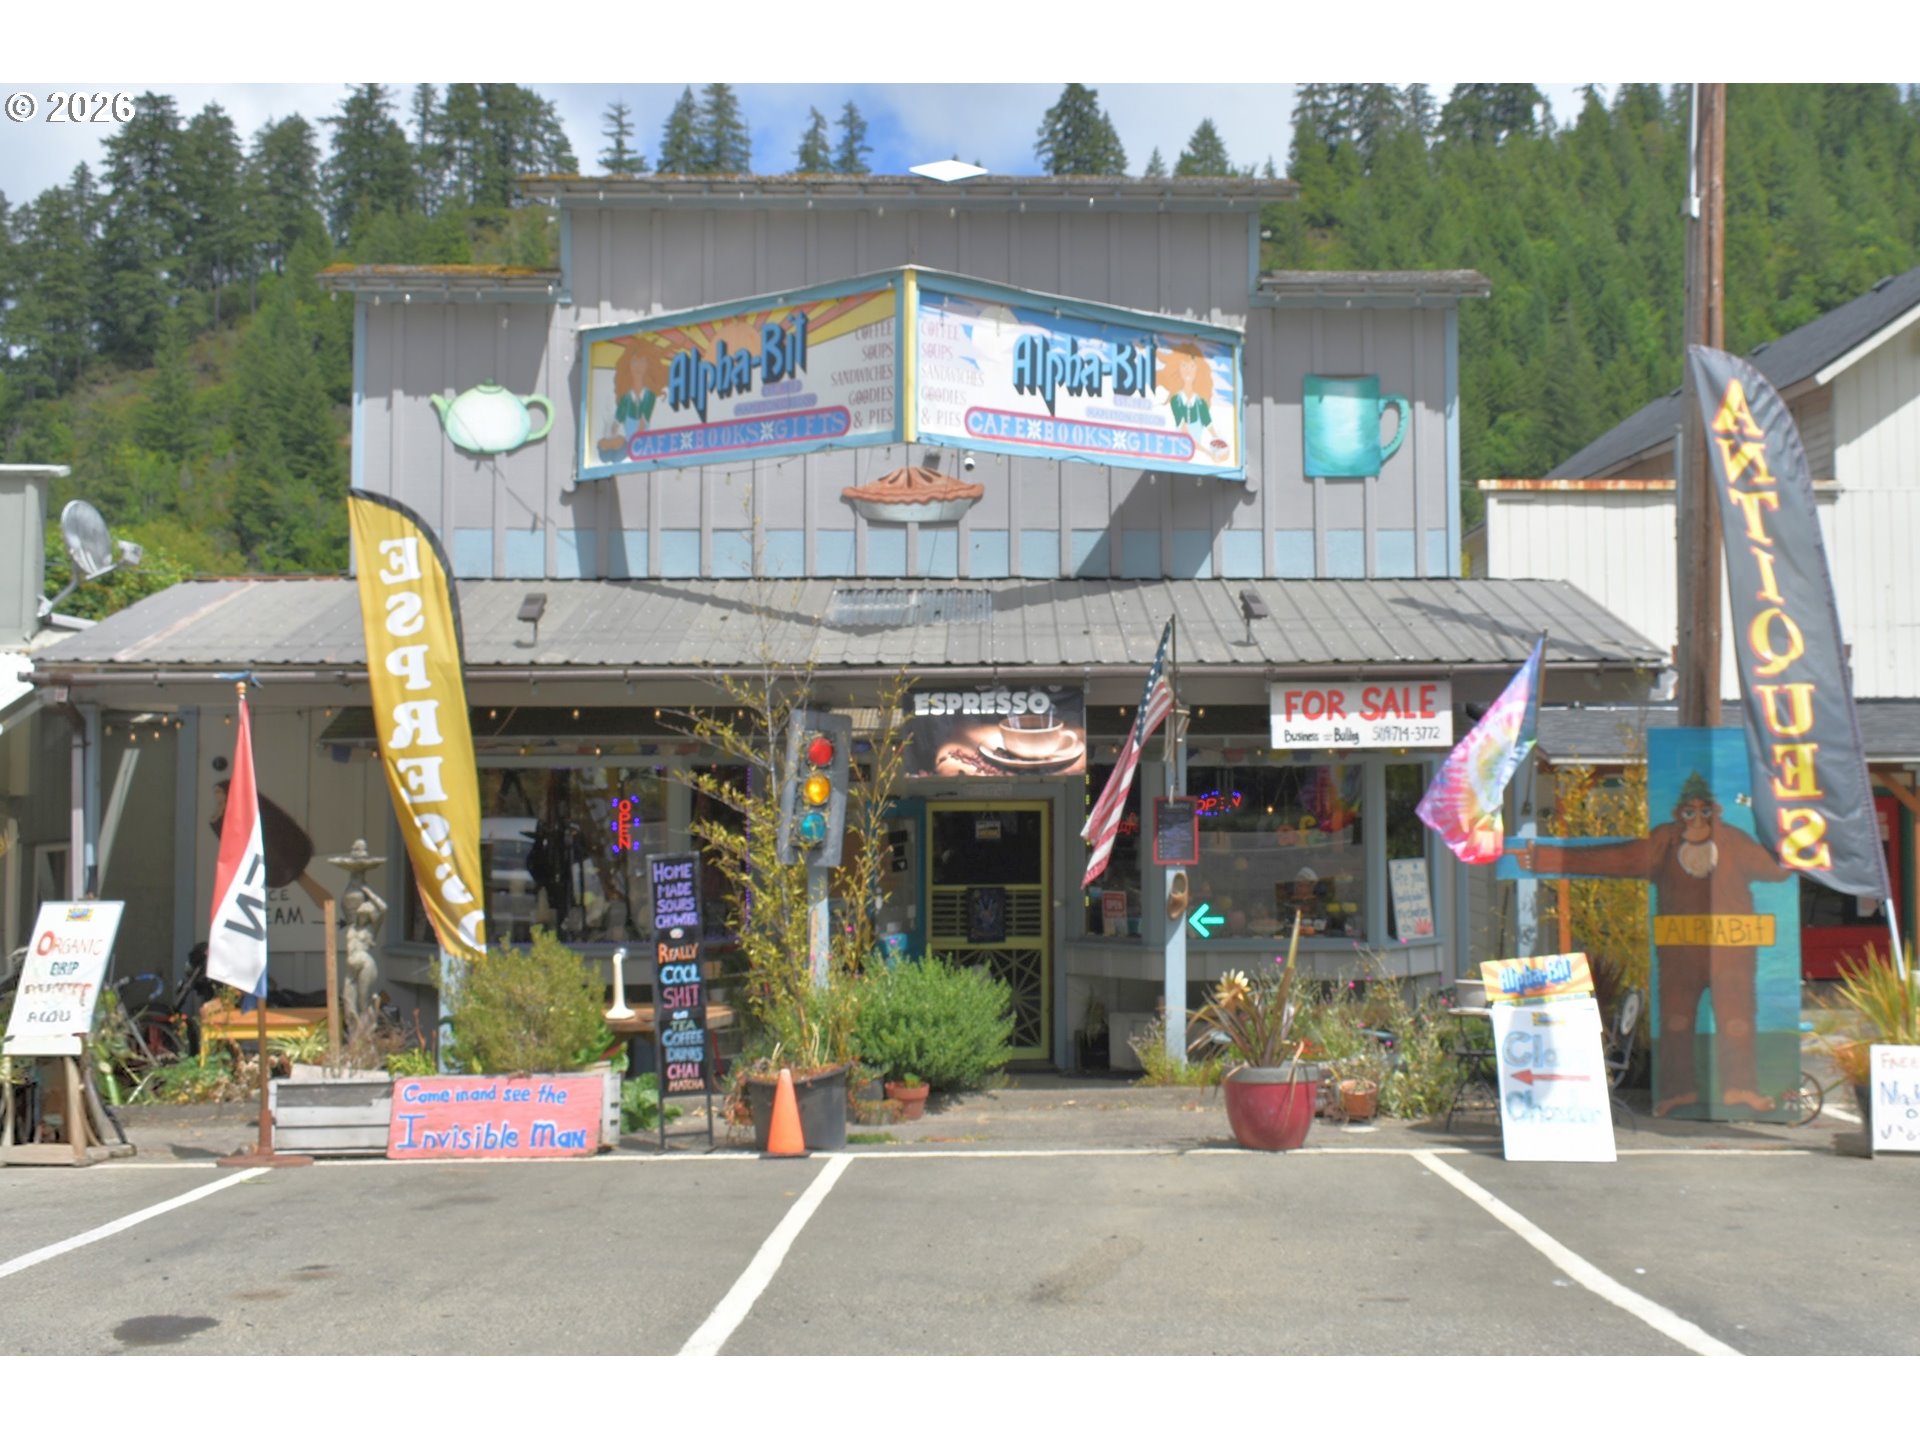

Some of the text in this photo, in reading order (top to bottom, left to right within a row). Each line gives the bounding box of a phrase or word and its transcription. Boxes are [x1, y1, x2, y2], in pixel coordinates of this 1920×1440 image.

[921, 319, 959, 341] COFFEE
[861, 343, 894, 361] SOUPS
[921, 342, 953, 360] SOUPS
[668, 310, 808, 423] Alpha-Bit
[830, 364, 894, 387] SANDWICHES
[921, 364, 985, 387] SANDWICHES
[1012, 334, 1157, 416] Alpha-Bit
[848, 386, 894, 406] GOODIES
[921, 387, 967, 406] GOODIES
[853, 408, 894, 429] & PIES
[921, 408, 961, 428] & PIES
[630, 410, 846, 457] CAFE BOOKS GIFTS
[968, 412, 1192, 458] CAFE BOOKS GIFTS
[913, 691, 1050, 716] ESPRESSO
[1284, 684, 1438, 722] FOR SALE
[619, 799, 632, 850] OPEN
[653, 861, 693, 883] HOME
[657, 881, 692, 899] MADE
[36, 930, 104, 956] ORGANIC
[660, 963, 700, 985] COOL
[663, 983, 699, 1009] SHIT
[662, 1029, 704, 1047] COFFEE
[667, 1062, 699, 1080] CHAI
[503, 1088, 531, 1102] see
[538, 1085, 568, 1104] the
[396, 1114, 519, 1150] Invisible
